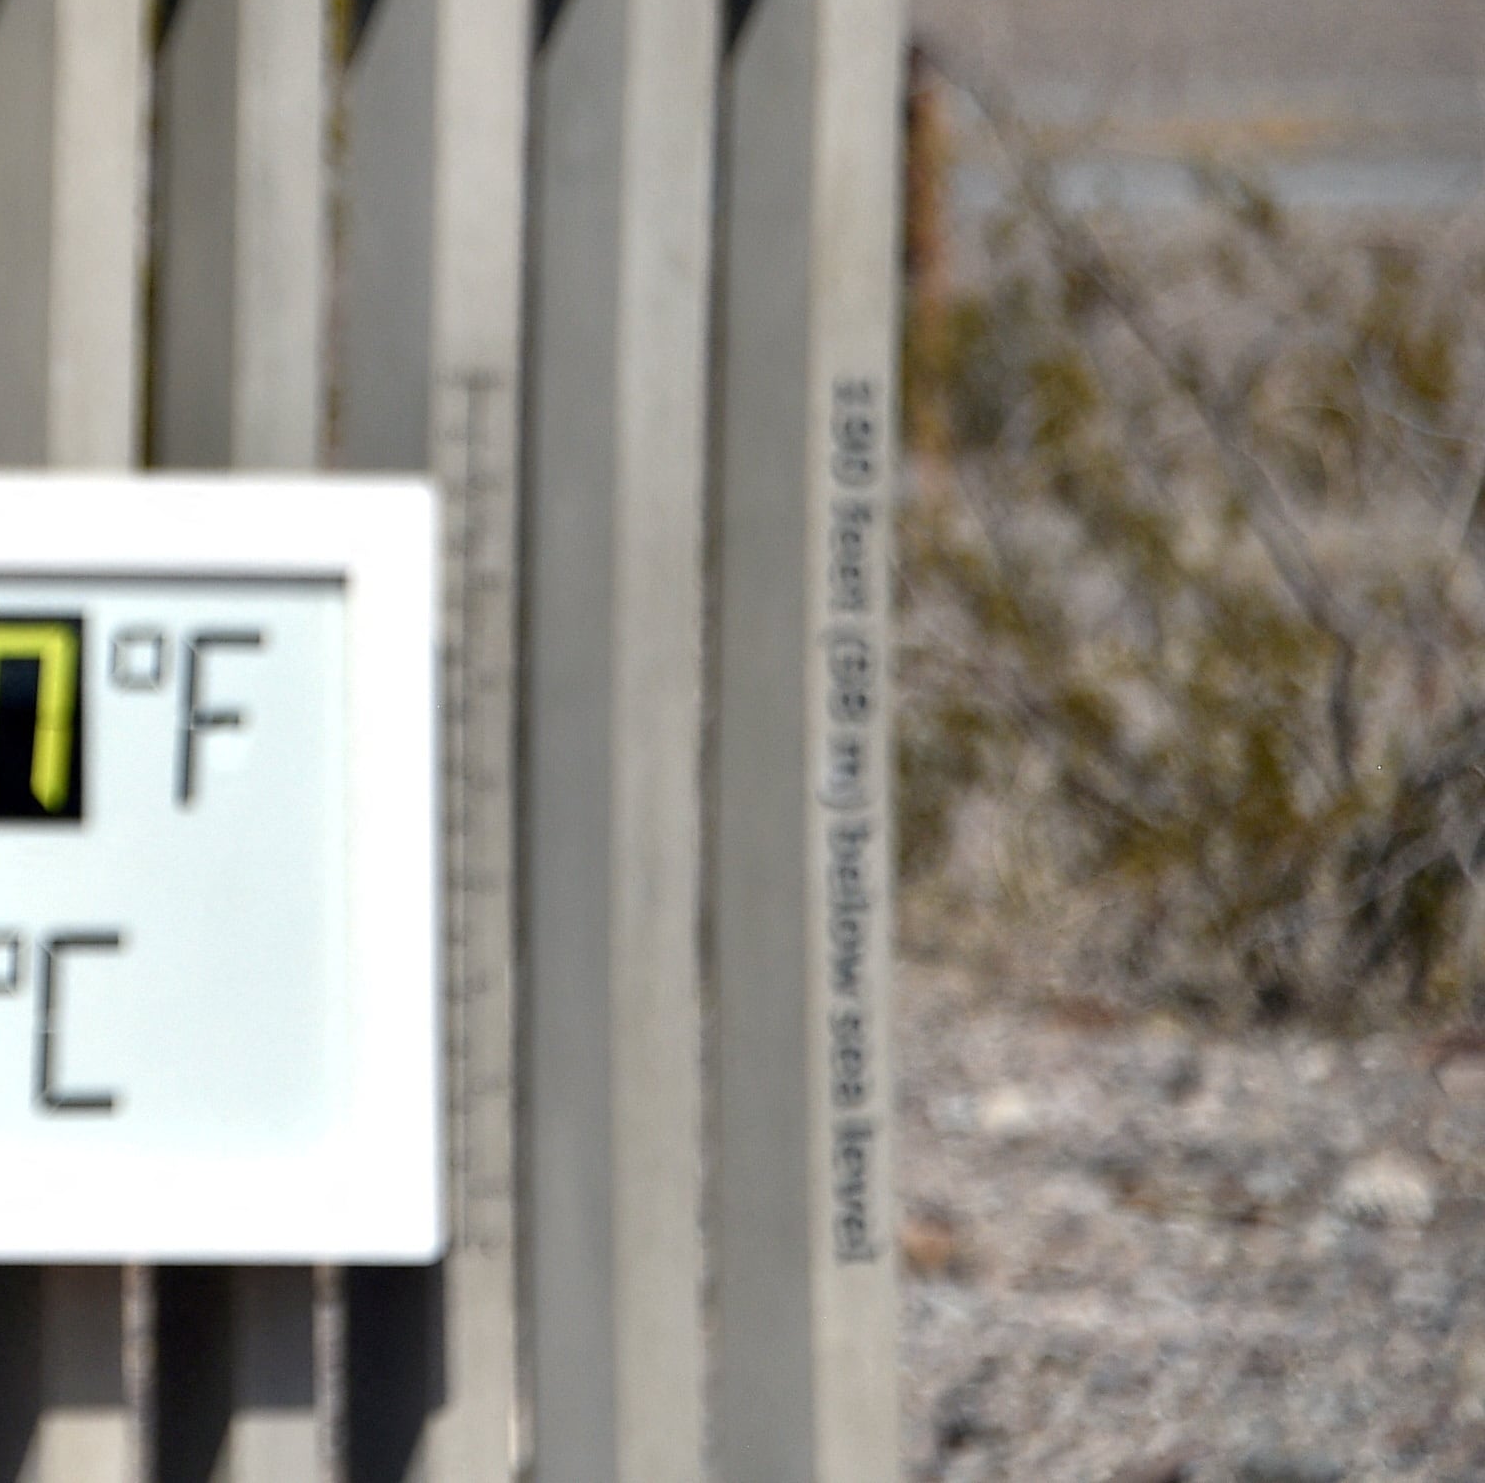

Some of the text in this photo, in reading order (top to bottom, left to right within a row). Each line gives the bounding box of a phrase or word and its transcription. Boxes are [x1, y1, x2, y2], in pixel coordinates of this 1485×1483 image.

[829, 820, 877, 995] below
[829, 1013, 871, 1107] sea
[833, 1120, 878, 1266] level
